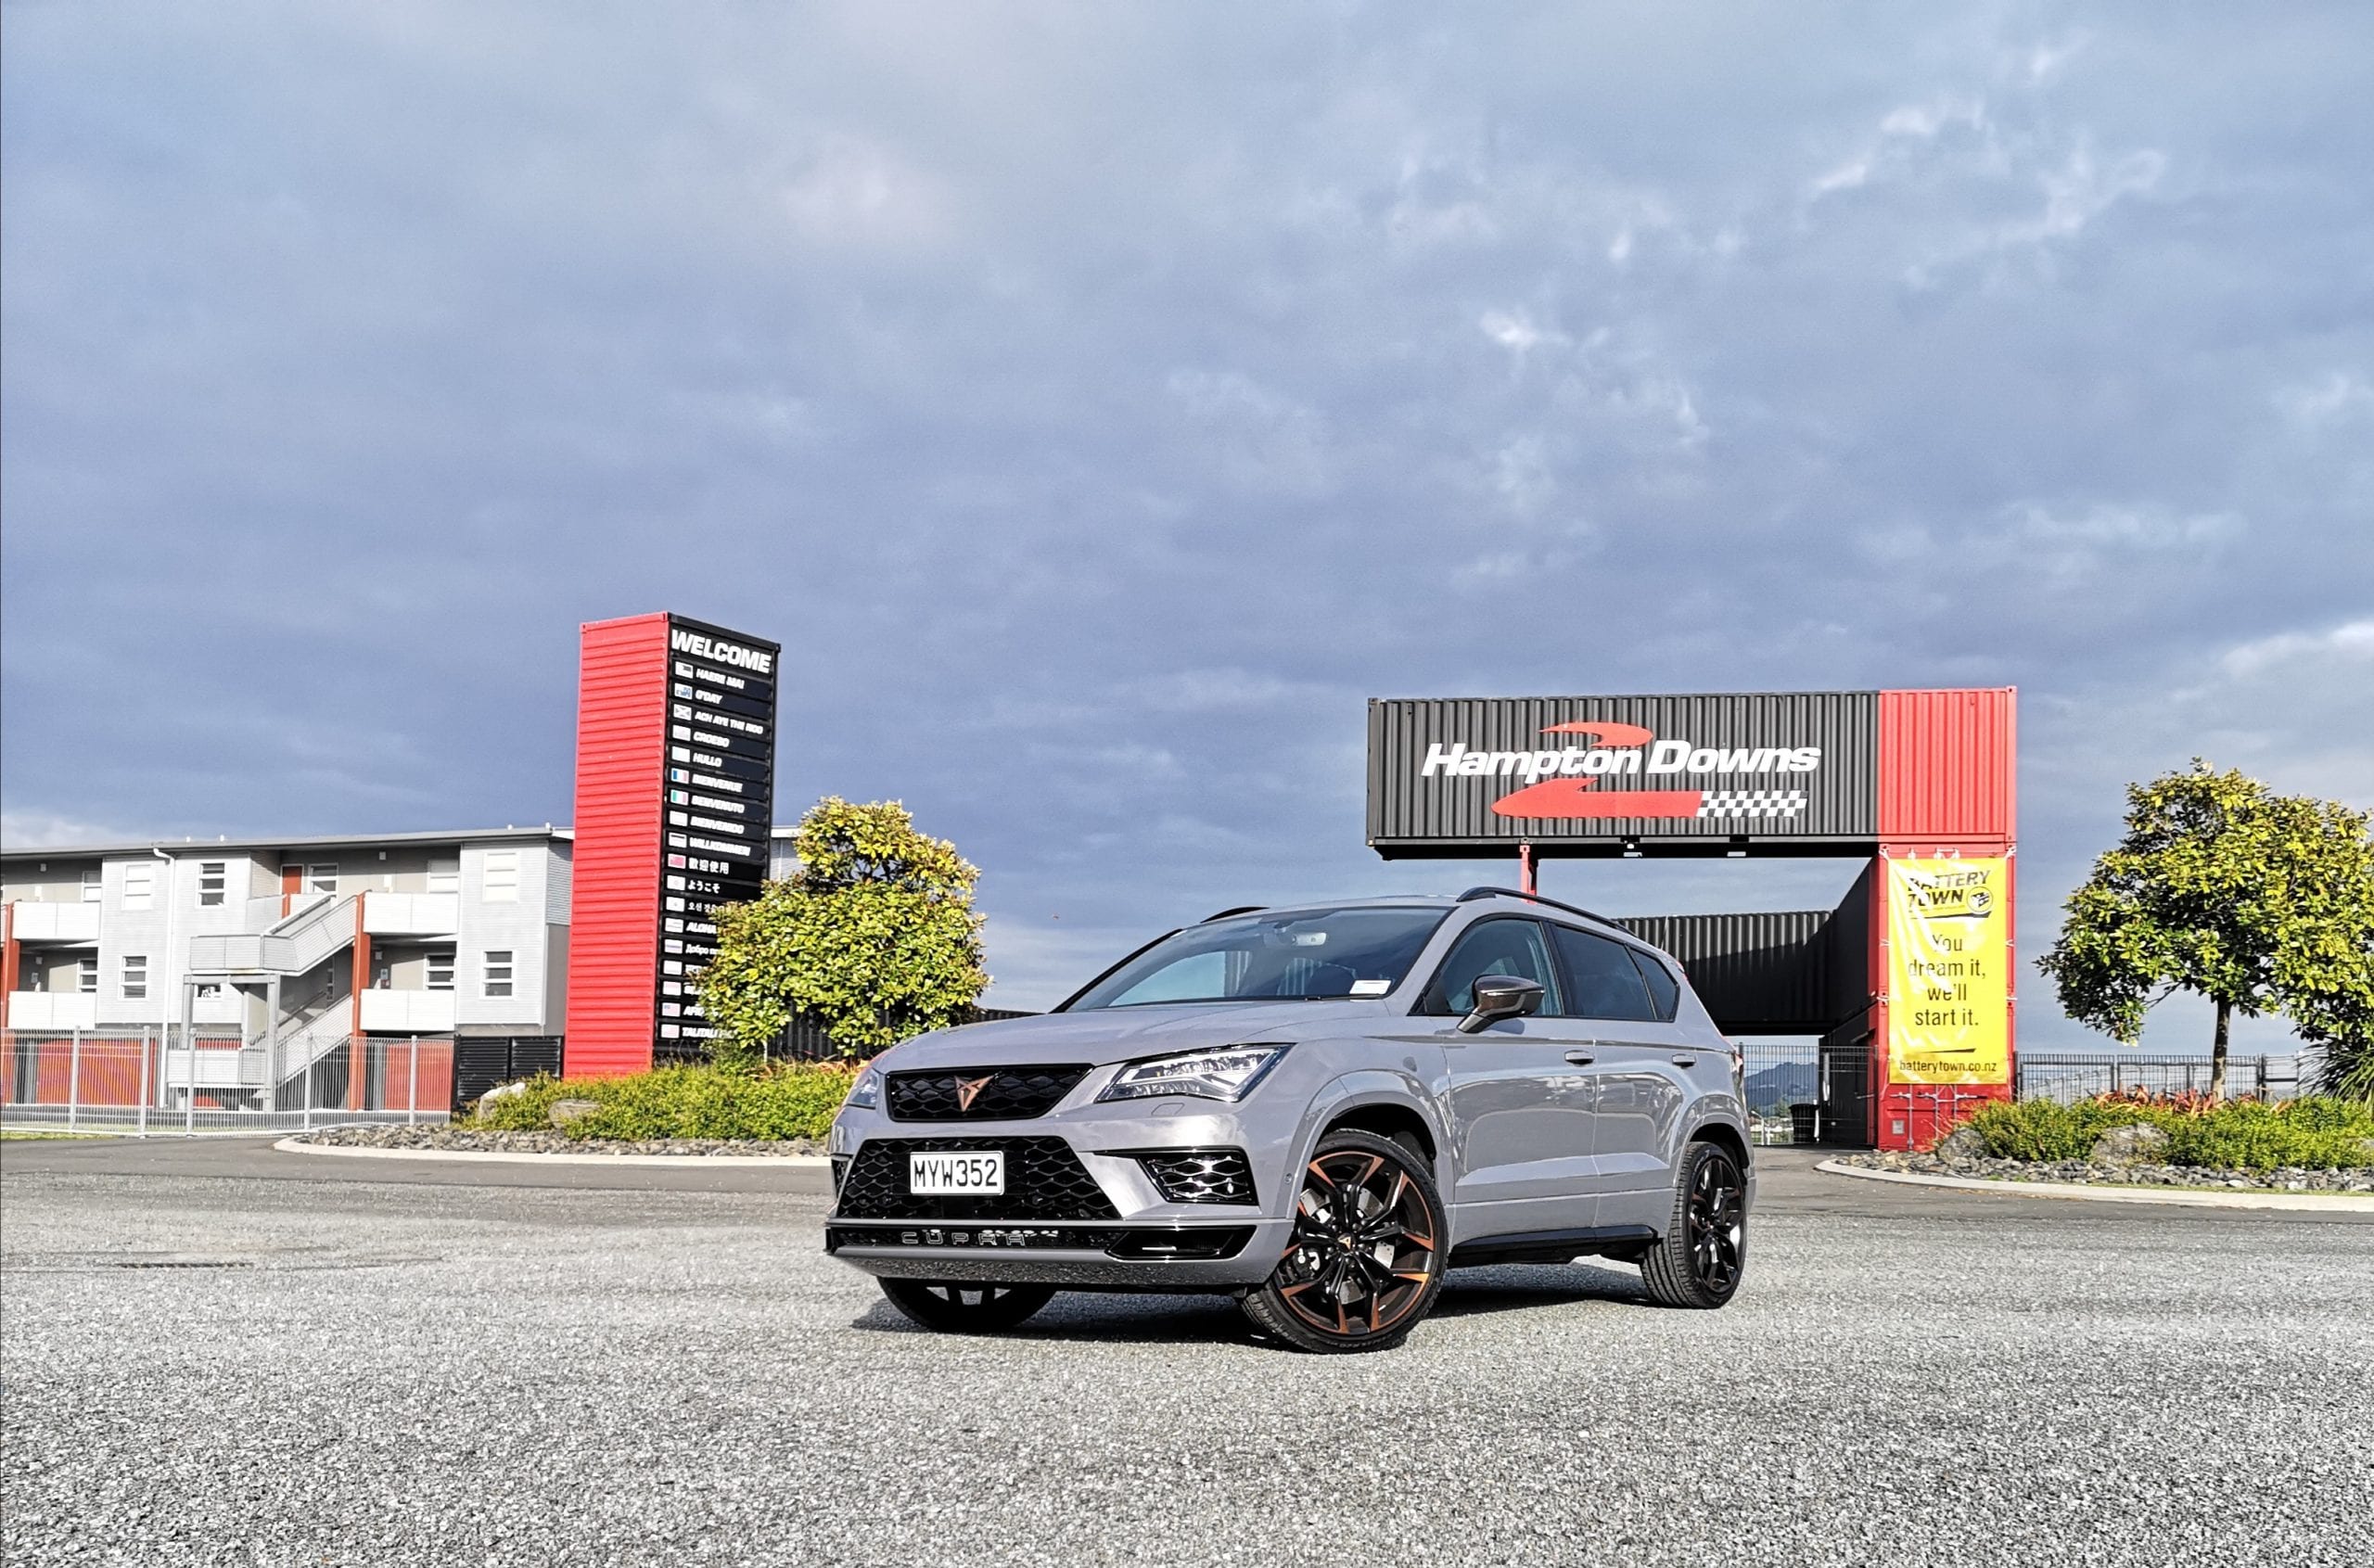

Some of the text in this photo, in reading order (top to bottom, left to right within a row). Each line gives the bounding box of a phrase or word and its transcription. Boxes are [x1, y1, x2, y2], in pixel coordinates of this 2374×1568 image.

[671, 630, 772, 673] WELCOME
[696, 690, 722, 704] G'DAY
[713, 715, 729, 726] AYE
[730, 719, 746, 731] THE
[1421, 740, 1822, 784] Hampton Downs
[687, 879, 721, 894] ようこそ
[1908, 889, 1963, 907] TOWN
[1933, 934, 1962, 951] You
[1908, 959, 1985, 979] dream it,
[1928, 983, 1967, 1001] we'll
[1915, 1009, 1979, 1026] start it.
[1899, 1061, 1997, 1074] batterytown.co.nz
[913, 1159, 998, 1188] MYW352
[901, 1231, 1026, 1246] CUPRA
